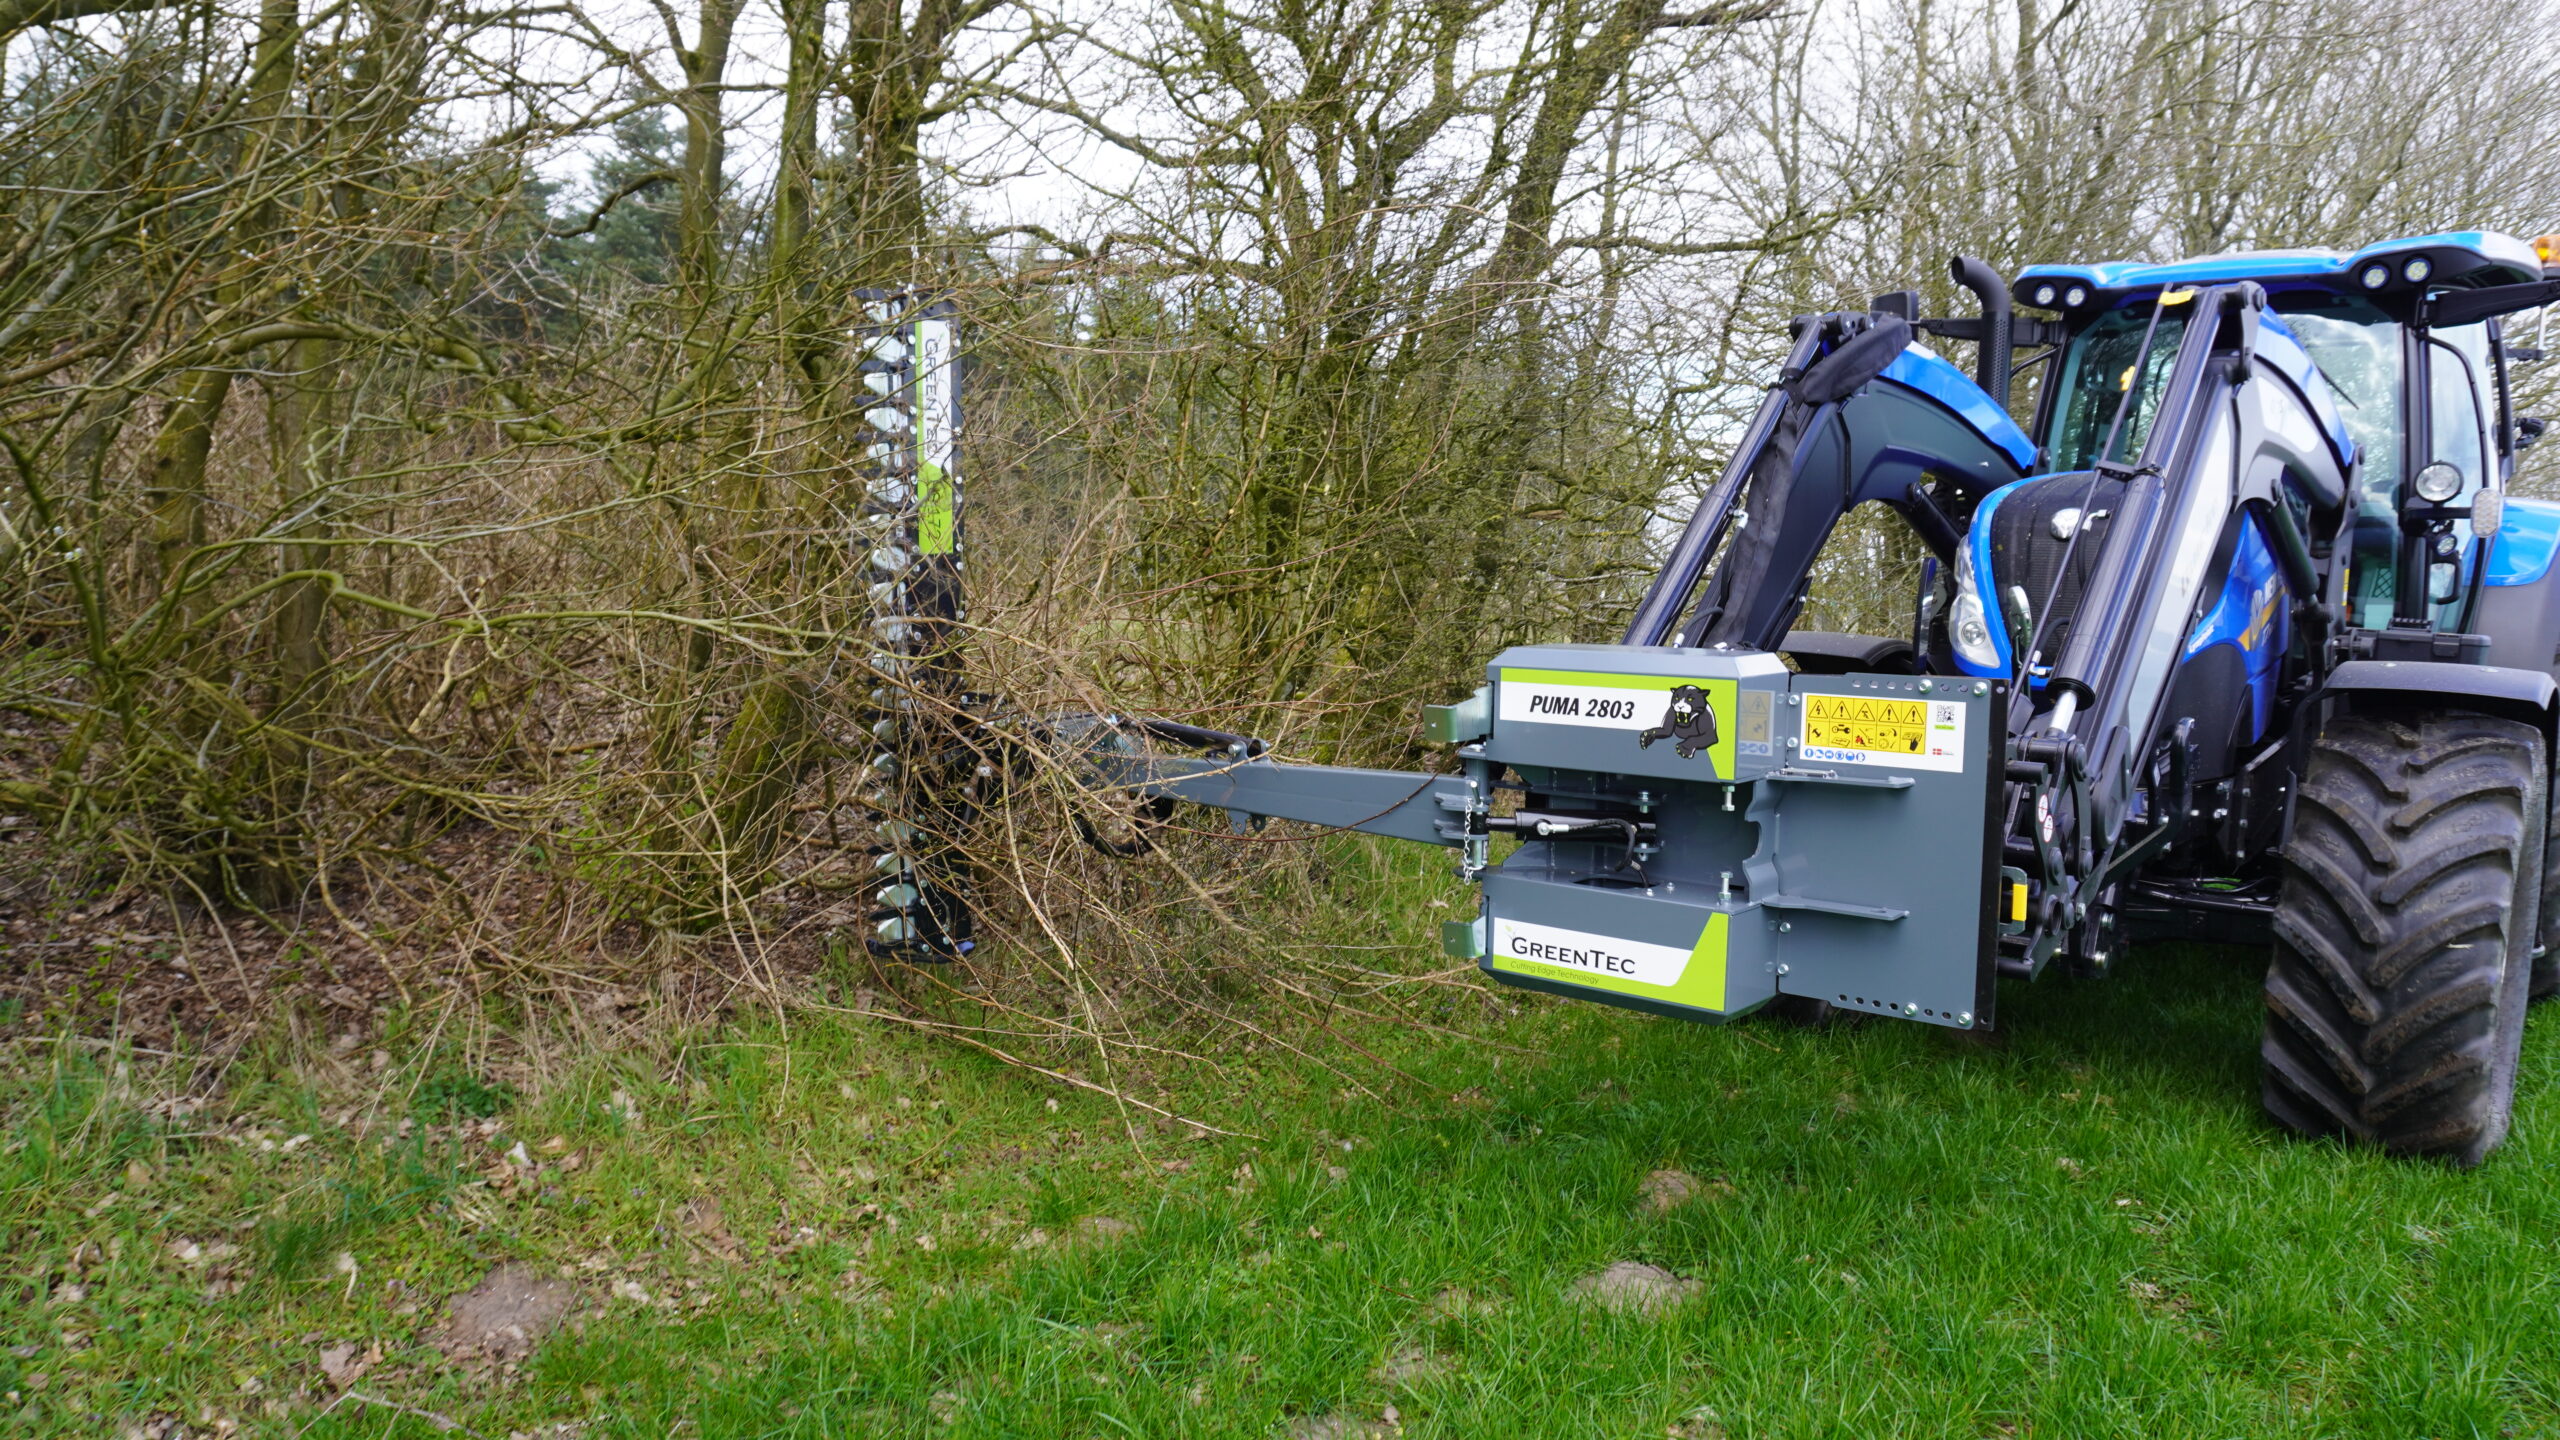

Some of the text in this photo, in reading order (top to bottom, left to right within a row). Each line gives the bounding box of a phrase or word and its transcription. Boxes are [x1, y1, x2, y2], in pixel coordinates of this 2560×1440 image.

[1529, 695, 1635, 720] PUMA 2803
[1510, 960, 1600, 985] Cutting Edge Technology
